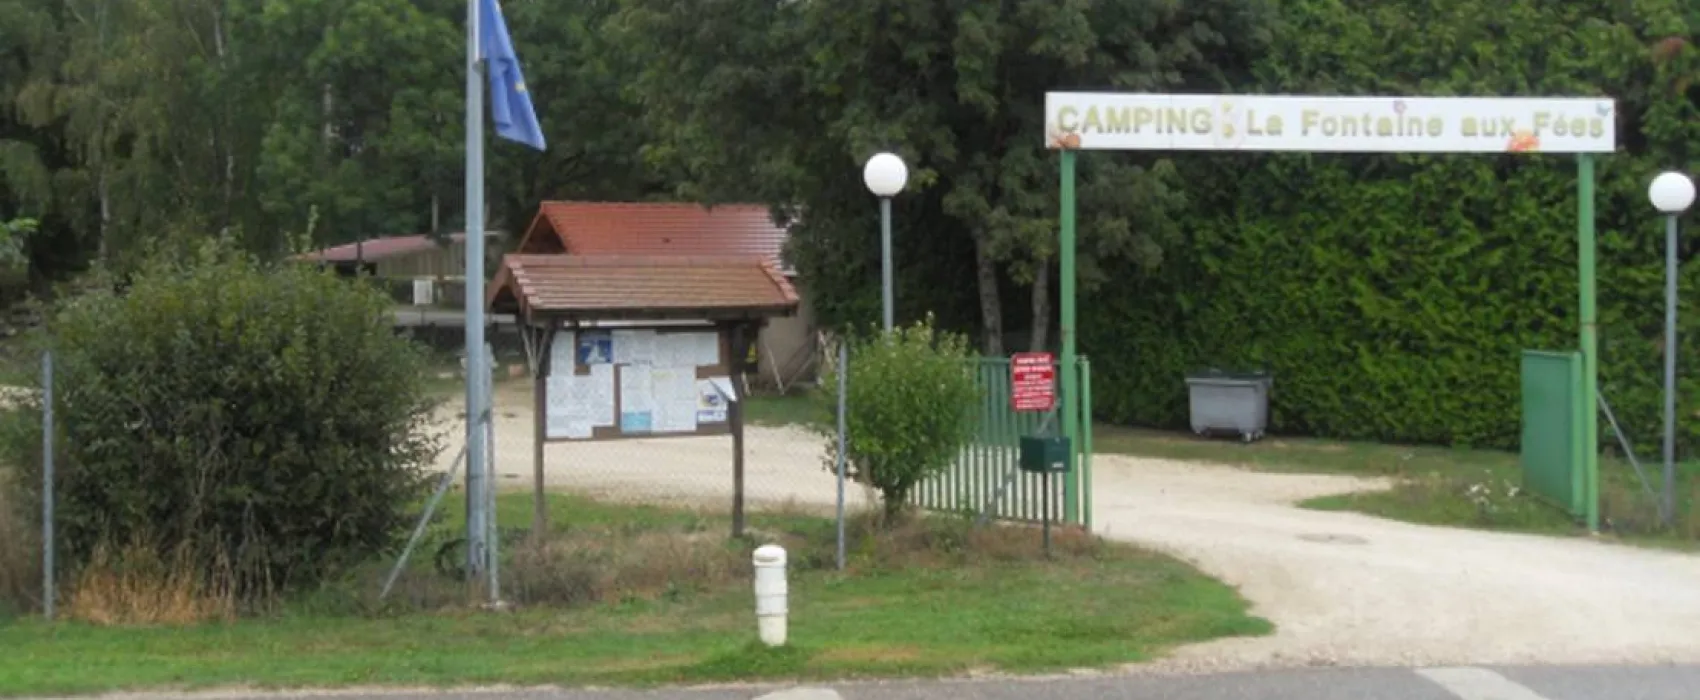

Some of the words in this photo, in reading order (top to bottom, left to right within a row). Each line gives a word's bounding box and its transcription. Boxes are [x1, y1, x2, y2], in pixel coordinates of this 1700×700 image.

[1057, 105, 1214, 135] CAMPING
[1247, 109, 1283, 136] La
[1301, 108, 1443, 137] Fontaine
[1460, 116, 1516, 137] aux
